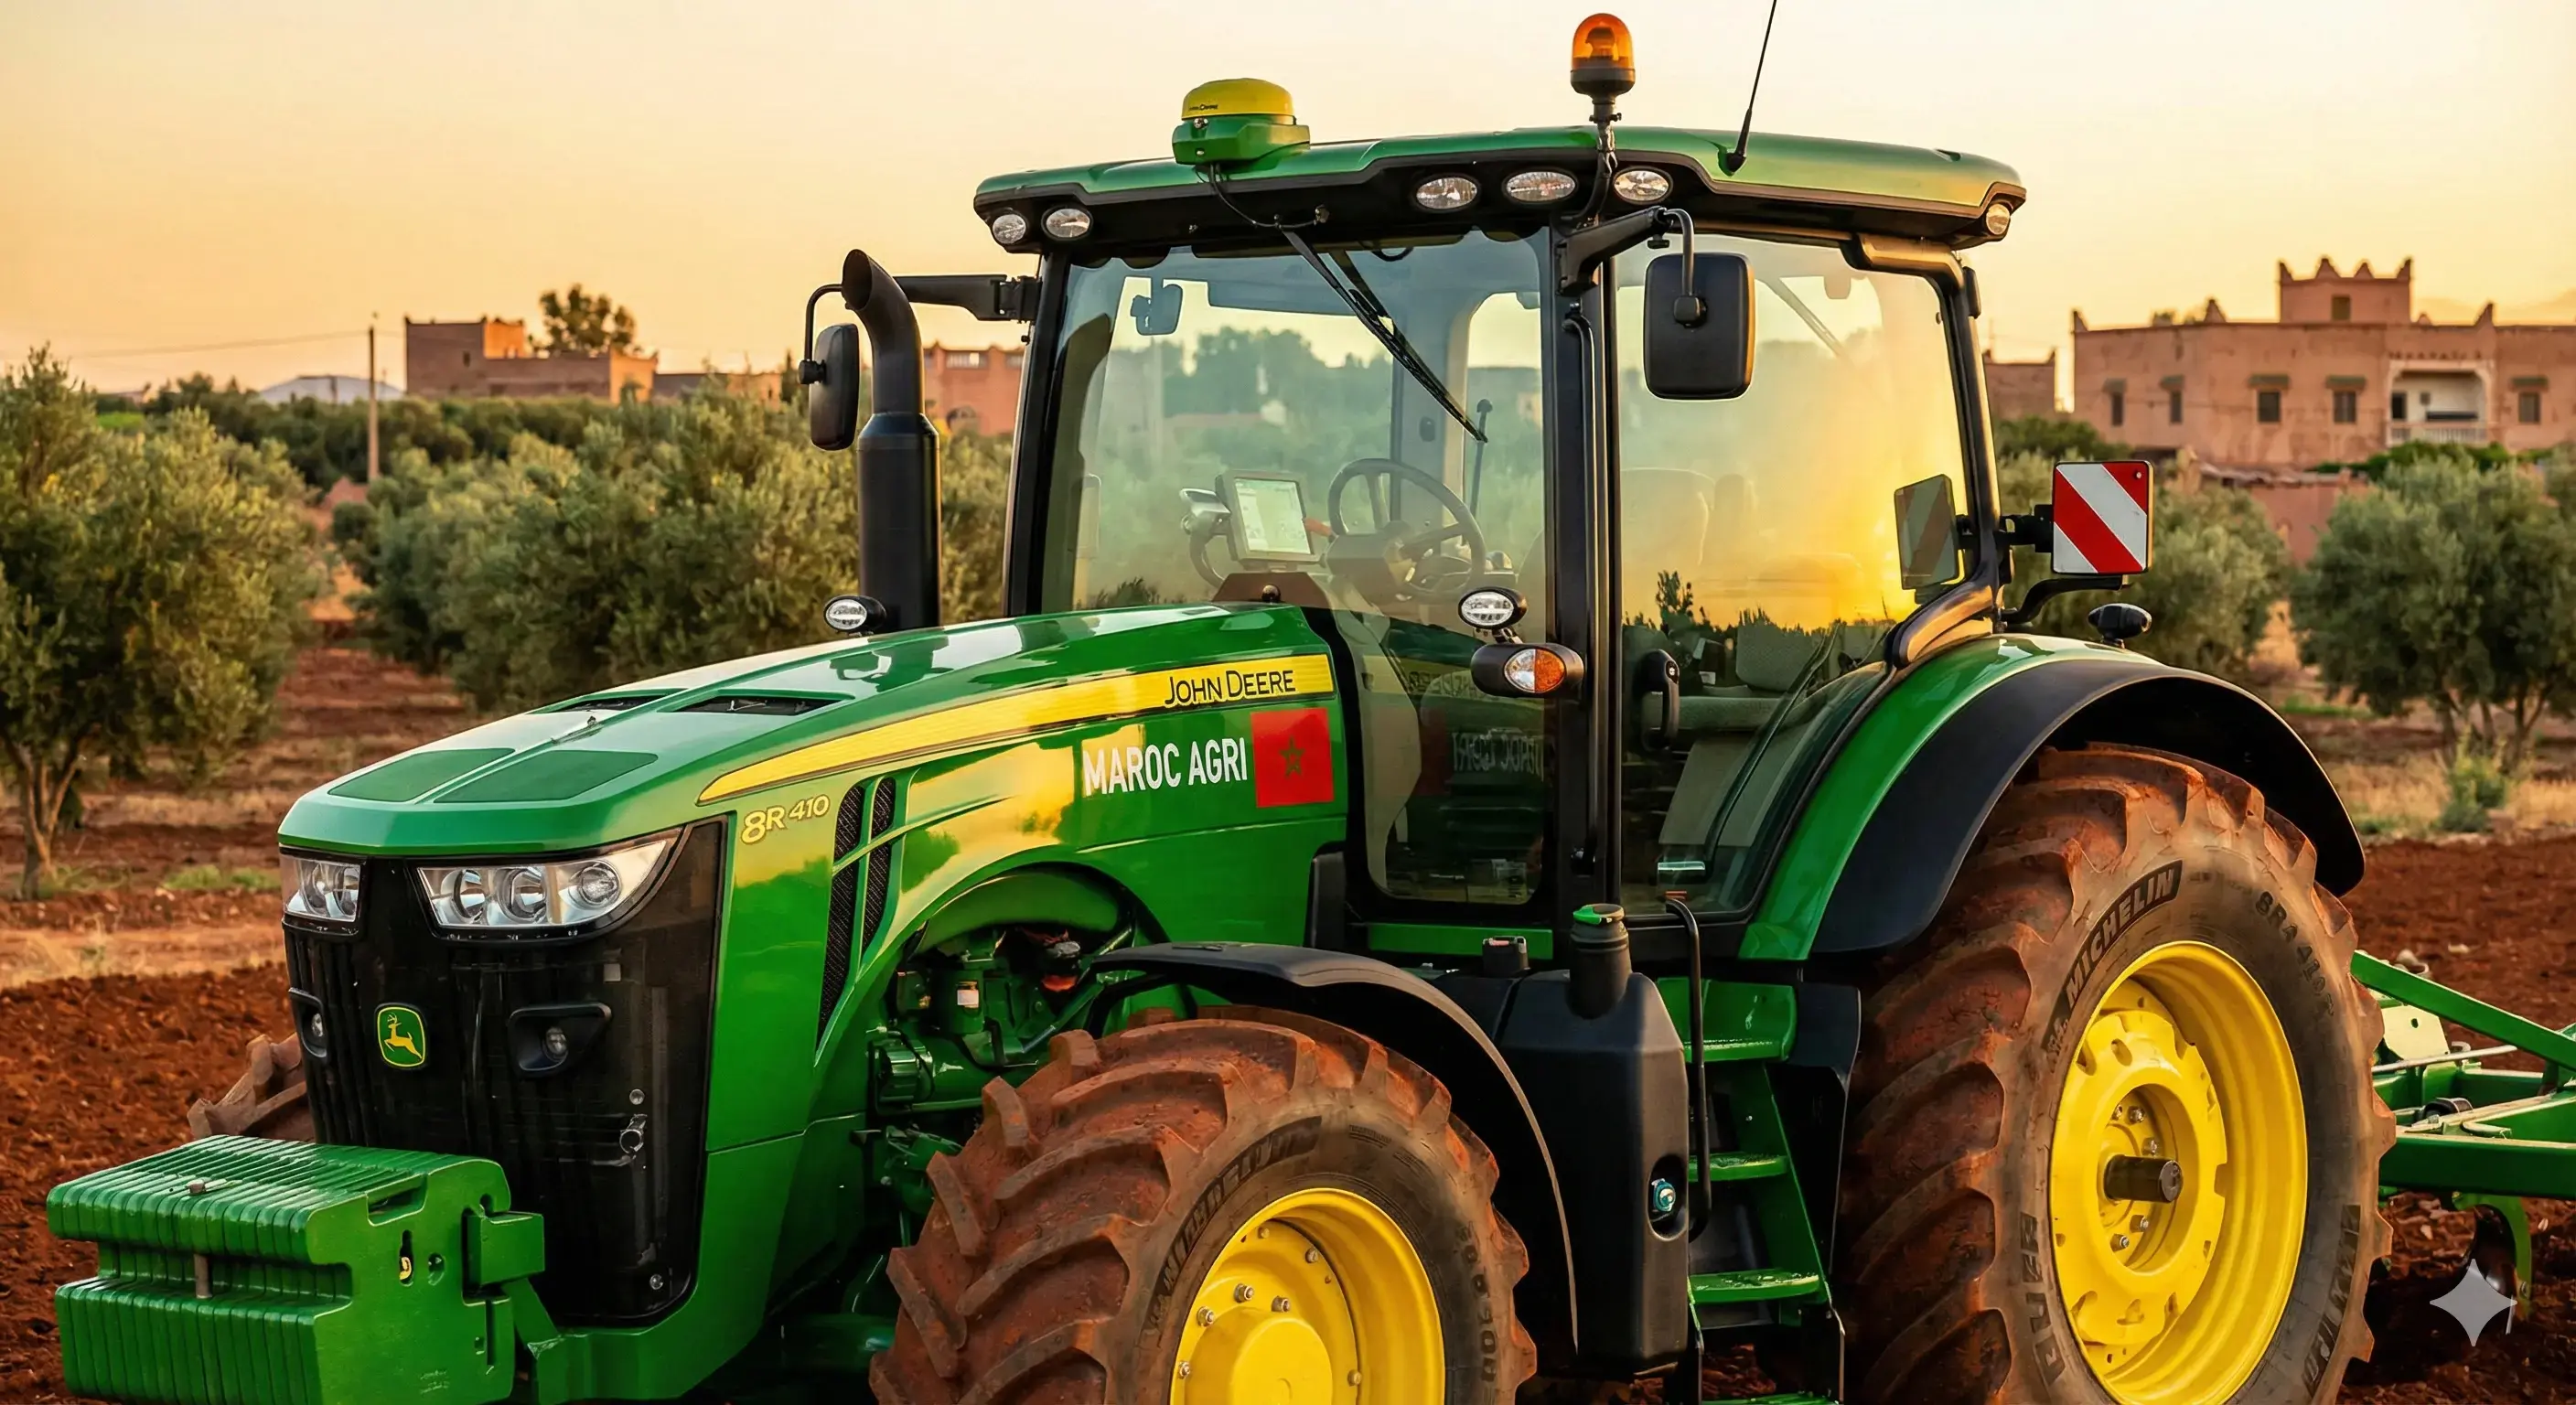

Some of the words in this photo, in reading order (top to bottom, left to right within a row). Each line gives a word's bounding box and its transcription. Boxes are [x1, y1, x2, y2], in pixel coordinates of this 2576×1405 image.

[1165, 676, 1222, 704] JOHN
[1226, 670, 1296, 698] DEERE
[1082, 742, 1182, 797] MAROC
[1188, 736, 1248, 786] AGRI
[741, 805, 786, 844] 8R
[789, 794, 831, 821] 410
[2065, 868, 2174, 1010] MICHELIN
